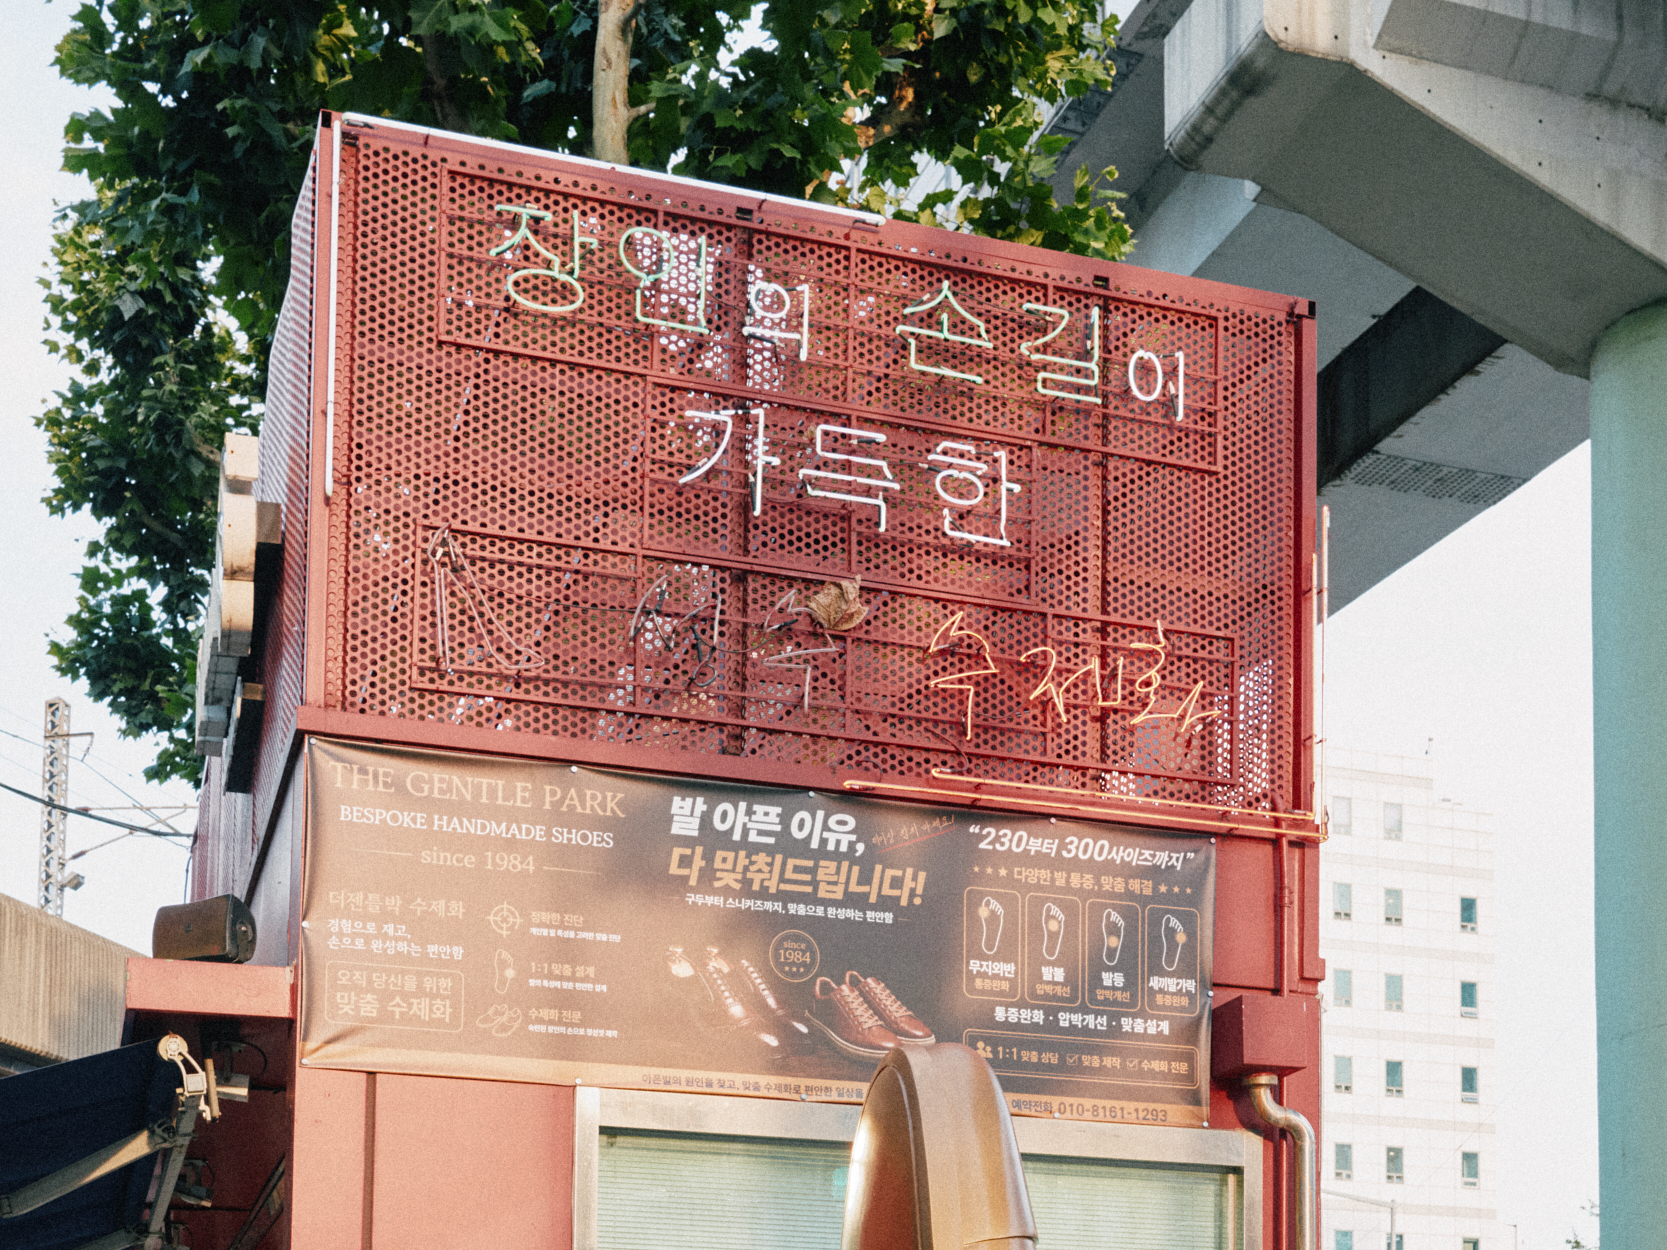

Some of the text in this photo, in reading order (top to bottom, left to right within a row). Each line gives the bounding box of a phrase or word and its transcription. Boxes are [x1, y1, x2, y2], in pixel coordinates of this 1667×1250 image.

[489, 204, 1184, 422] 장인의 손길이
[678, 407, 1021, 547] 가득한
[329, 761, 626, 818] THE GENTLE PARK
[339, 805, 614, 848] BESPOKE HANDMADE SHOES
[670, 796, 866, 856] 발 아픈 이유,
[421, 846, 535, 874] since 1984
[668, 846, 927, 907] 다 맞춰드립니다!
[1013, 867, 1153, 896] 다양한 발 통증, 맞춤 해결
[409, 897, 466, 920] 수제화
[530, 910, 584, 927] 정확한 진단
[685, 893, 894, 924] 구두부터 스니커즈까지, 맞춤으로 완성하는 편안함
[327, 918, 411, 939] 경험으로 재고,
[327, 935, 464, 960] 손으로 완성하는 편안함
[783, 939, 806, 950] since
[778, 949, 812, 964] 1984
[531, 962, 595, 978] 1:1 맞춤 설계
[968, 960, 1016, 978] 무지외반
[1101, 971, 1125, 987] 발등
[337, 970, 452, 995] 오직 당신을 위한
[974, 978, 1010, 992] 통증완화
[1035, 983, 1071, 997] 압박개선
[1148, 975, 1197, 994] 새끼발가락
[336, 991, 453, 1022] 맞춤 수제화
[1096, 989, 1130, 1002] 압박개선
[1155, 993, 1190, 1008] 통증완화
[528, 1008, 582, 1023] 수제화 전문
[994, 1006, 1170, 1035] 통증완화 압박개선 맞춤설계
[997, 1046, 1189, 1074] 1:1 맞춤 상담 맞춤 제작 수제화 전문
[684, 1076, 714, 1088] 원인을
[742, 1080, 761, 1092] 맞춤
[764, 1082, 801, 1095] 수제화로
[804, 1084, 833, 1096] 편안한
[835, 1086, 864, 1099] 일상을
[1011, 1098, 1168, 1122] 예약전화 010-8161-1293
